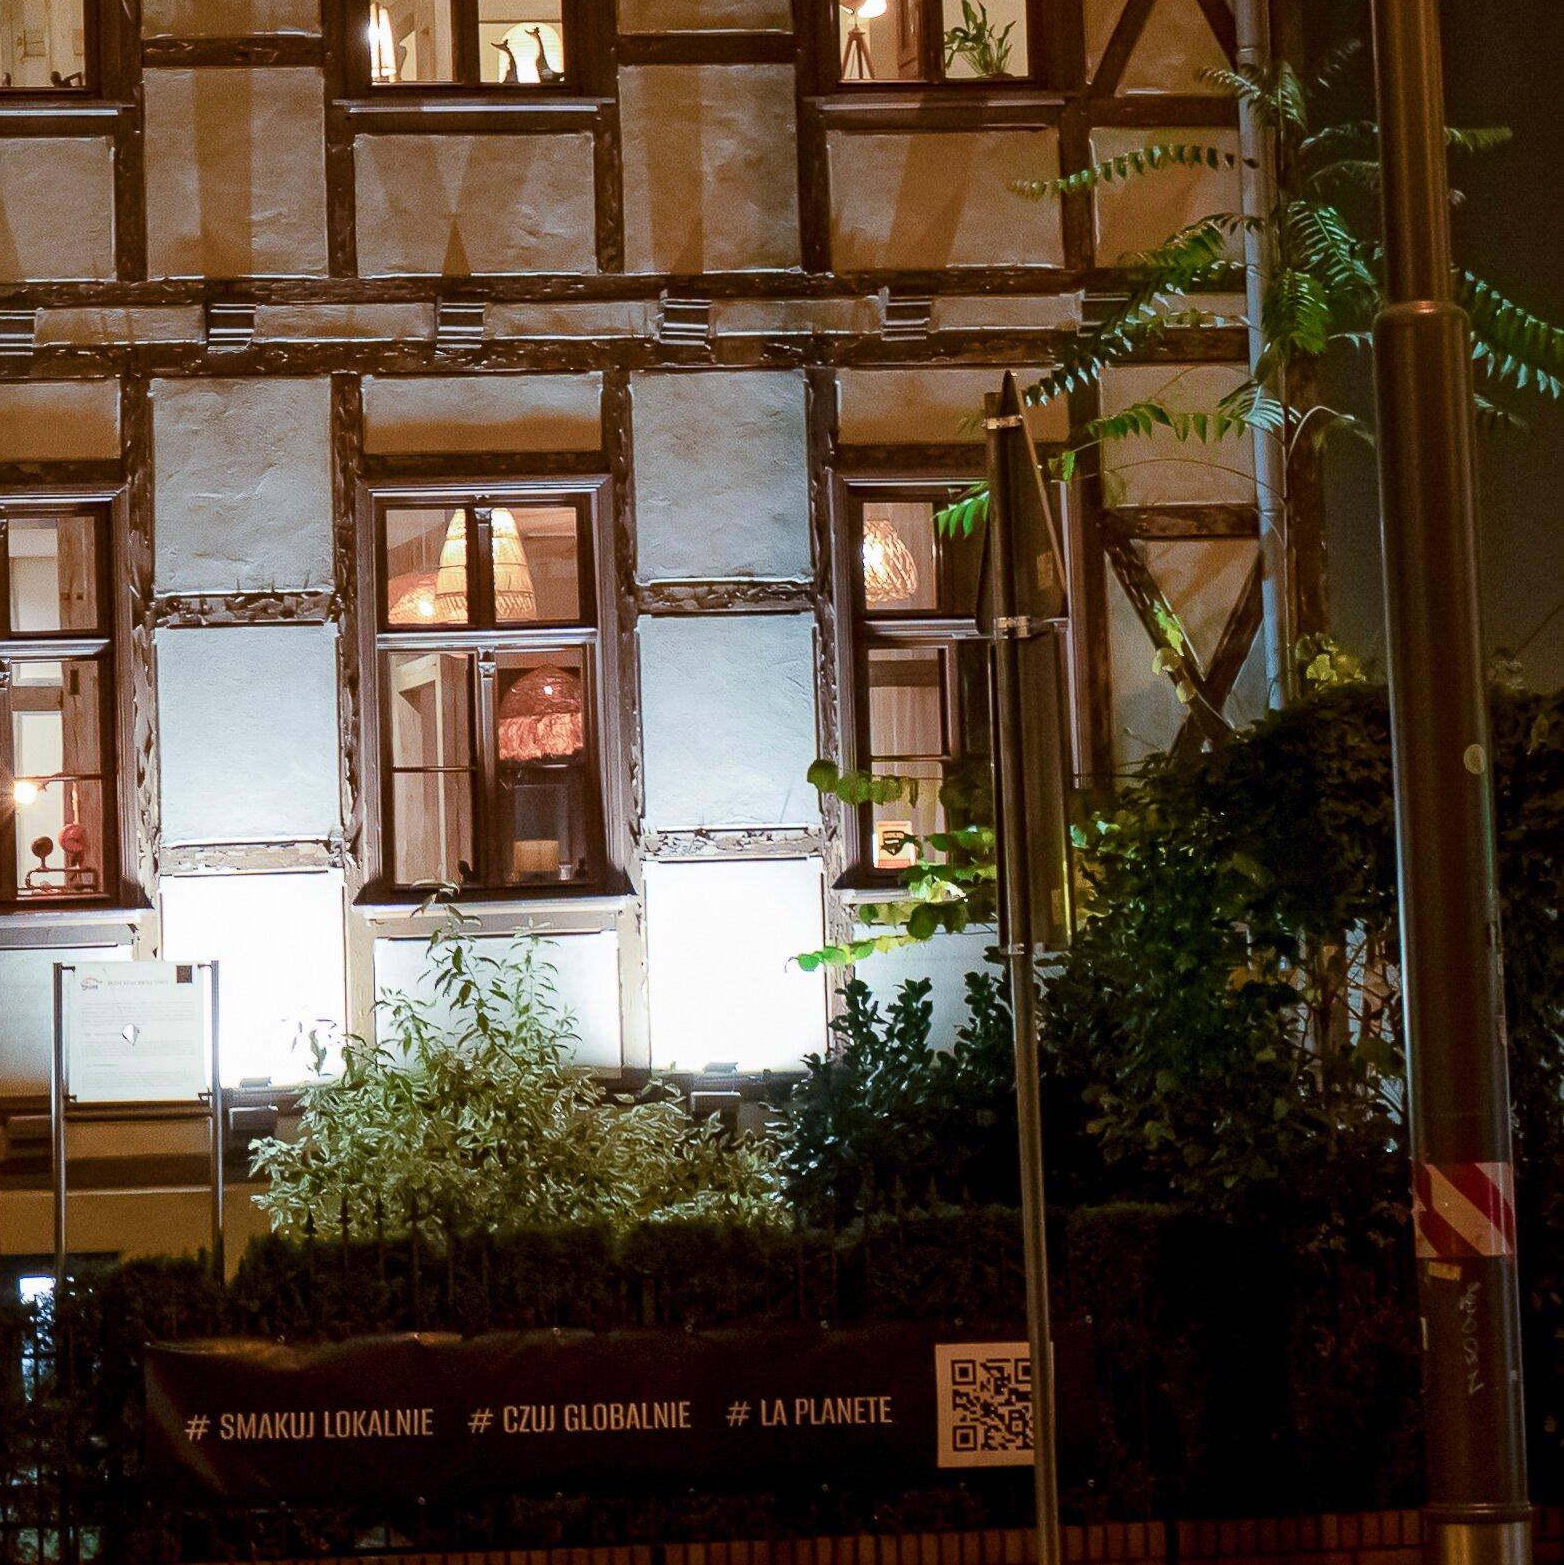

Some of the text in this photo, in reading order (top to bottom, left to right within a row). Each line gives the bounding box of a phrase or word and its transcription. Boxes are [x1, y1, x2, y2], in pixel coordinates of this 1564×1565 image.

[220, 1411, 315, 1440] SMAKUJ
[323, 1408, 434, 1438] LOKALNIE
[502, 1404, 556, 1434] CZUJ
[563, 1400, 692, 1432] GLOBALNIE
[760, 1399, 788, 1427] LA
[795, 1395, 893, 1426] PLANETE
